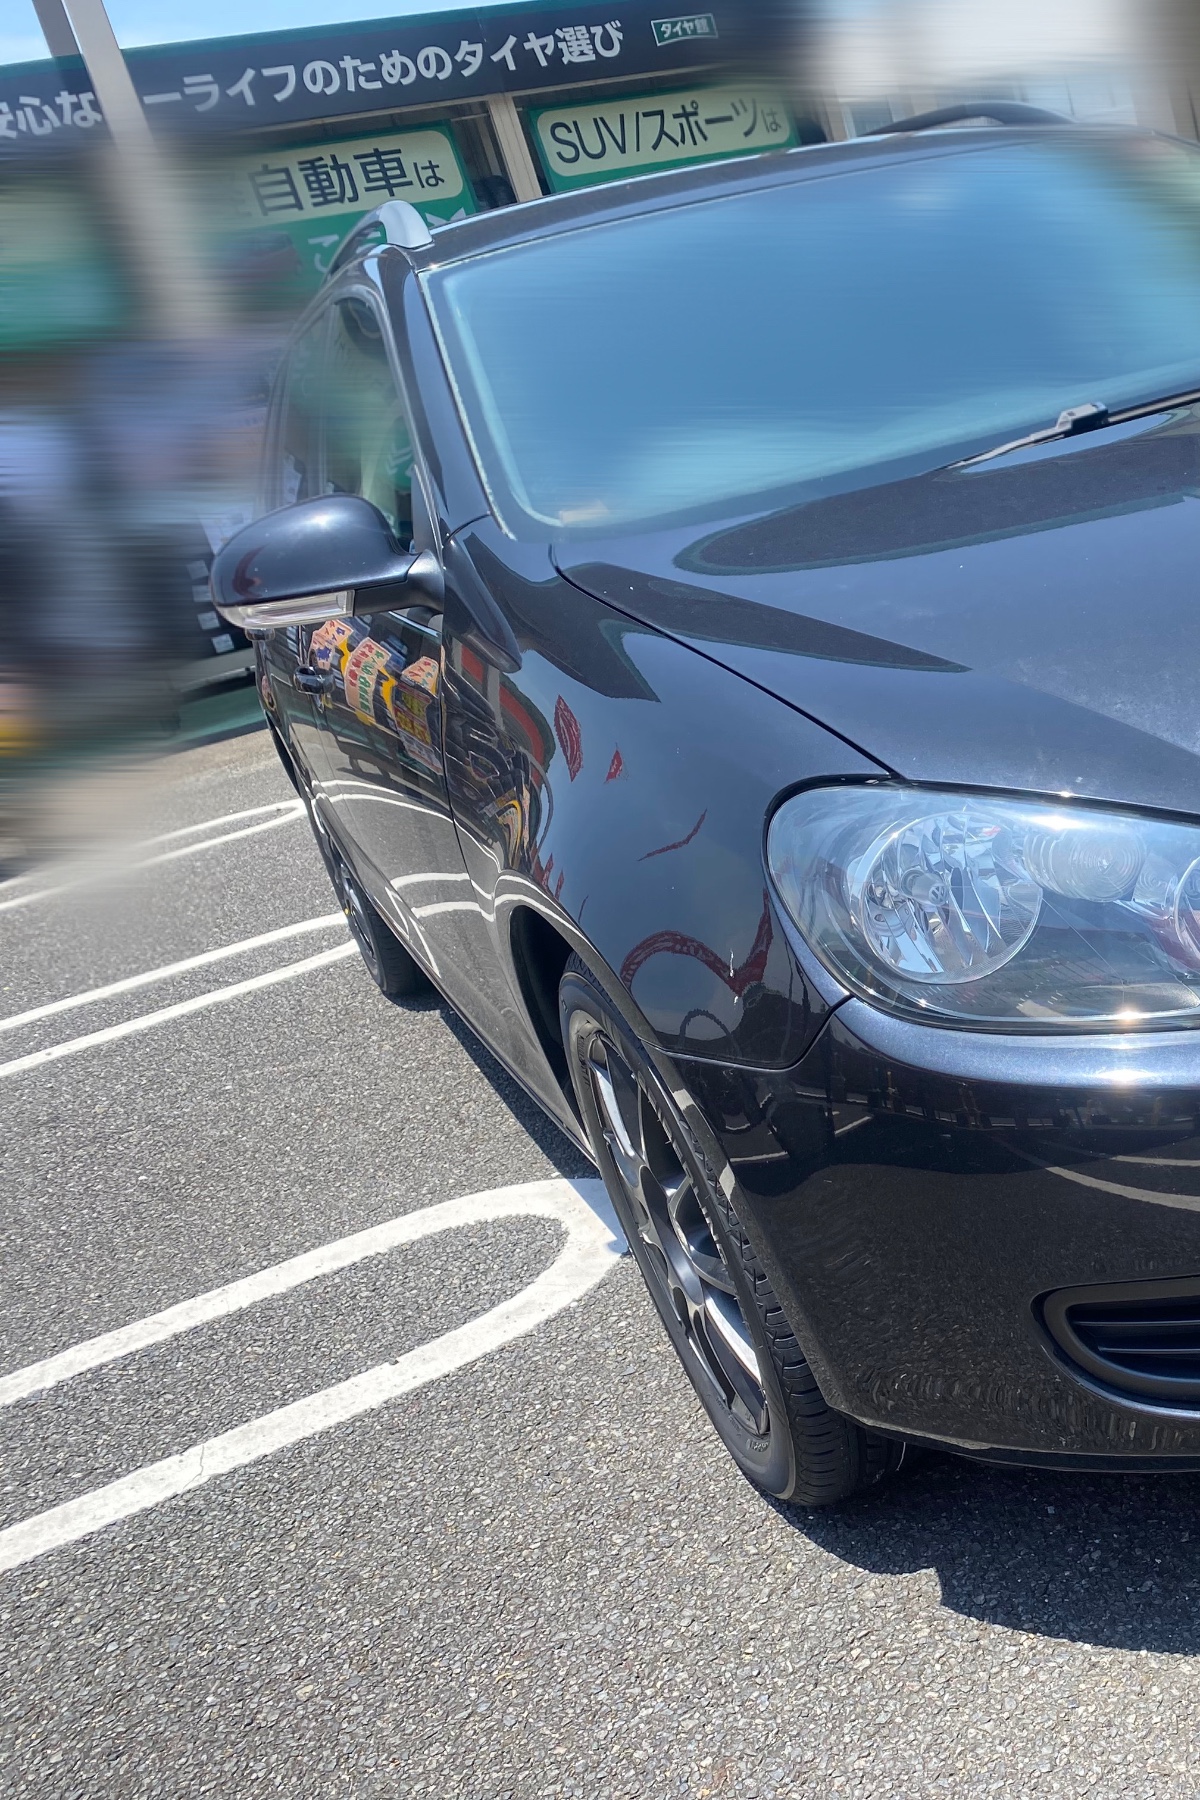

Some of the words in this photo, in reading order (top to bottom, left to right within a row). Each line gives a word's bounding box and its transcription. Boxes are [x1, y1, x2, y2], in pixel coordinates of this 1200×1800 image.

[0, 19, 624, 139] 心なーライフのためのタイヤ選び
[236, 148, 445, 217] 自動車は
